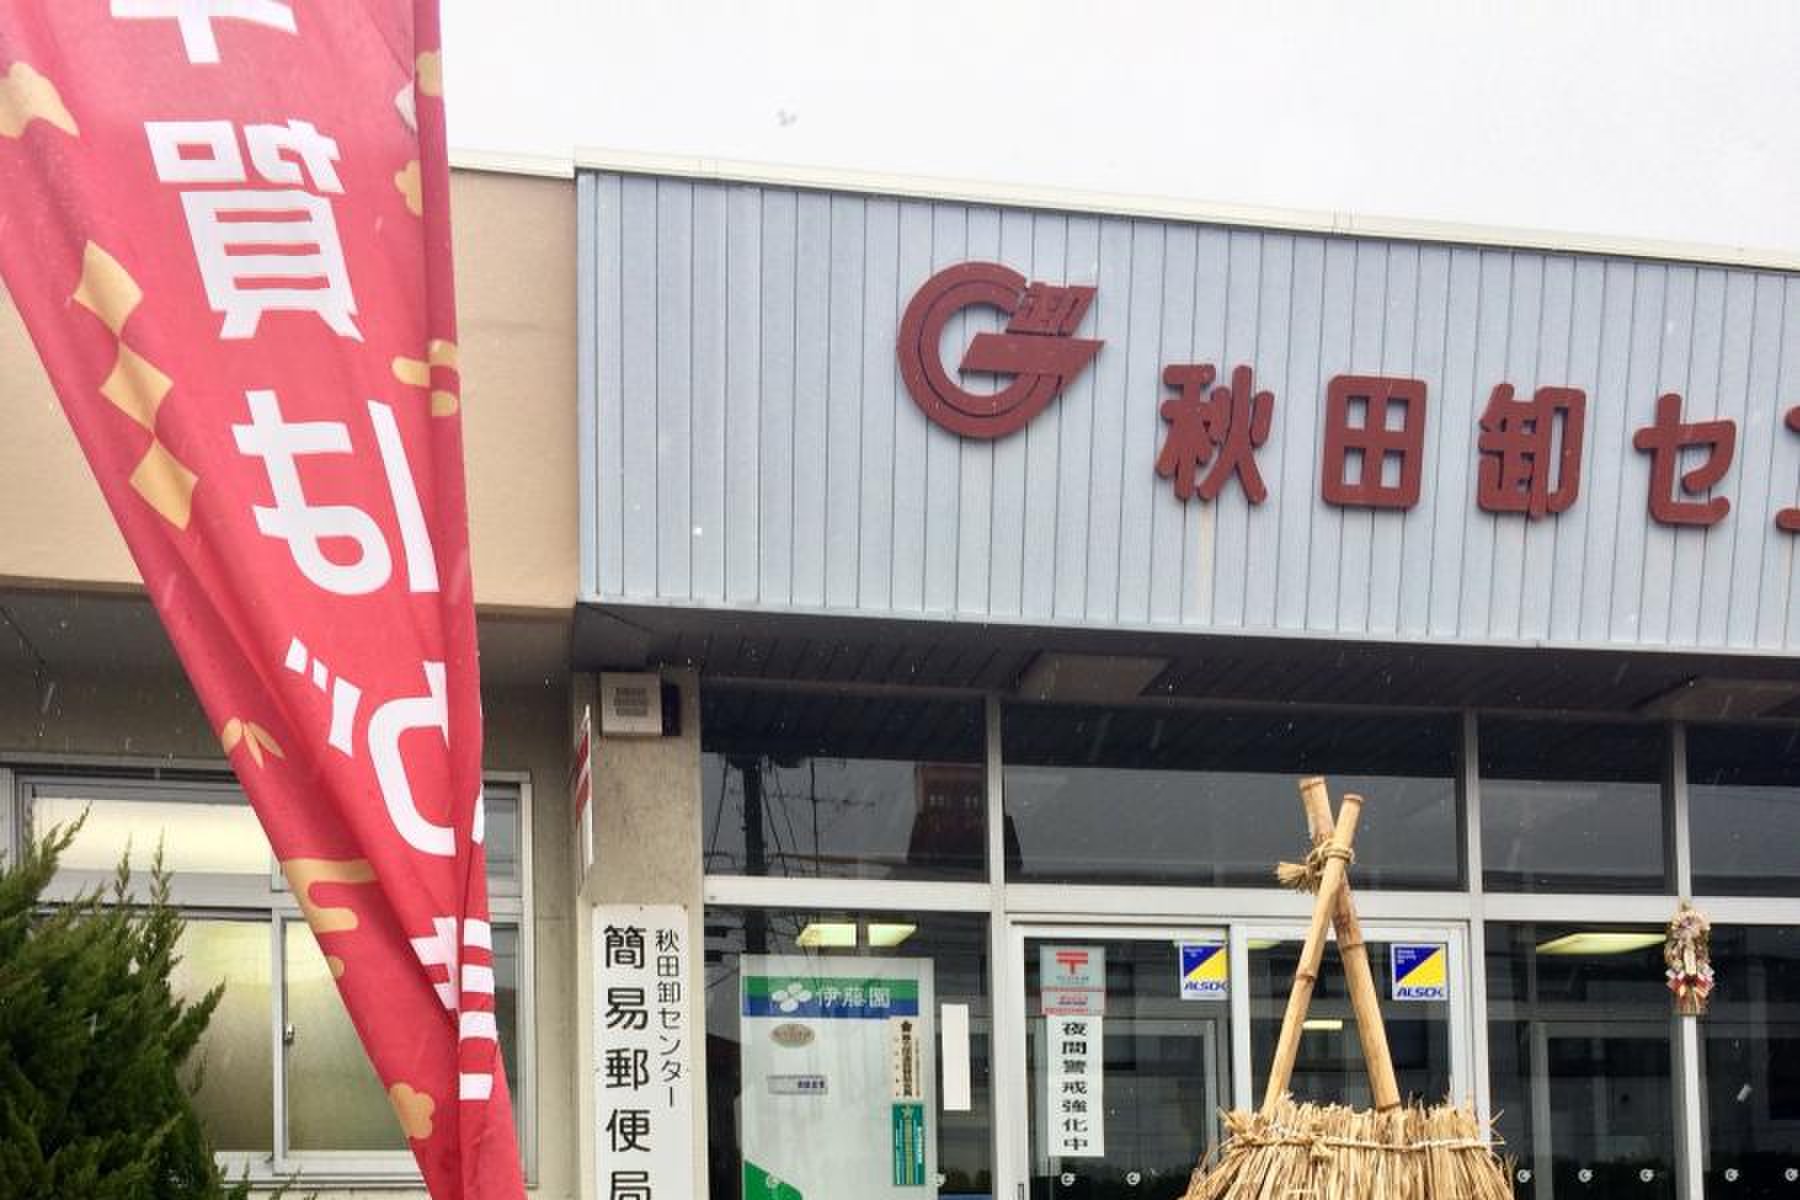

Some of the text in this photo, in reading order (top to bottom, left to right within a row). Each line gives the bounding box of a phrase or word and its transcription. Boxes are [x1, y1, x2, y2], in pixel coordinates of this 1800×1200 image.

[655, 928, 683, 1108] 秋田卸センター
[1061, 1021, 1089, 1152] 夜間警戒強化中
